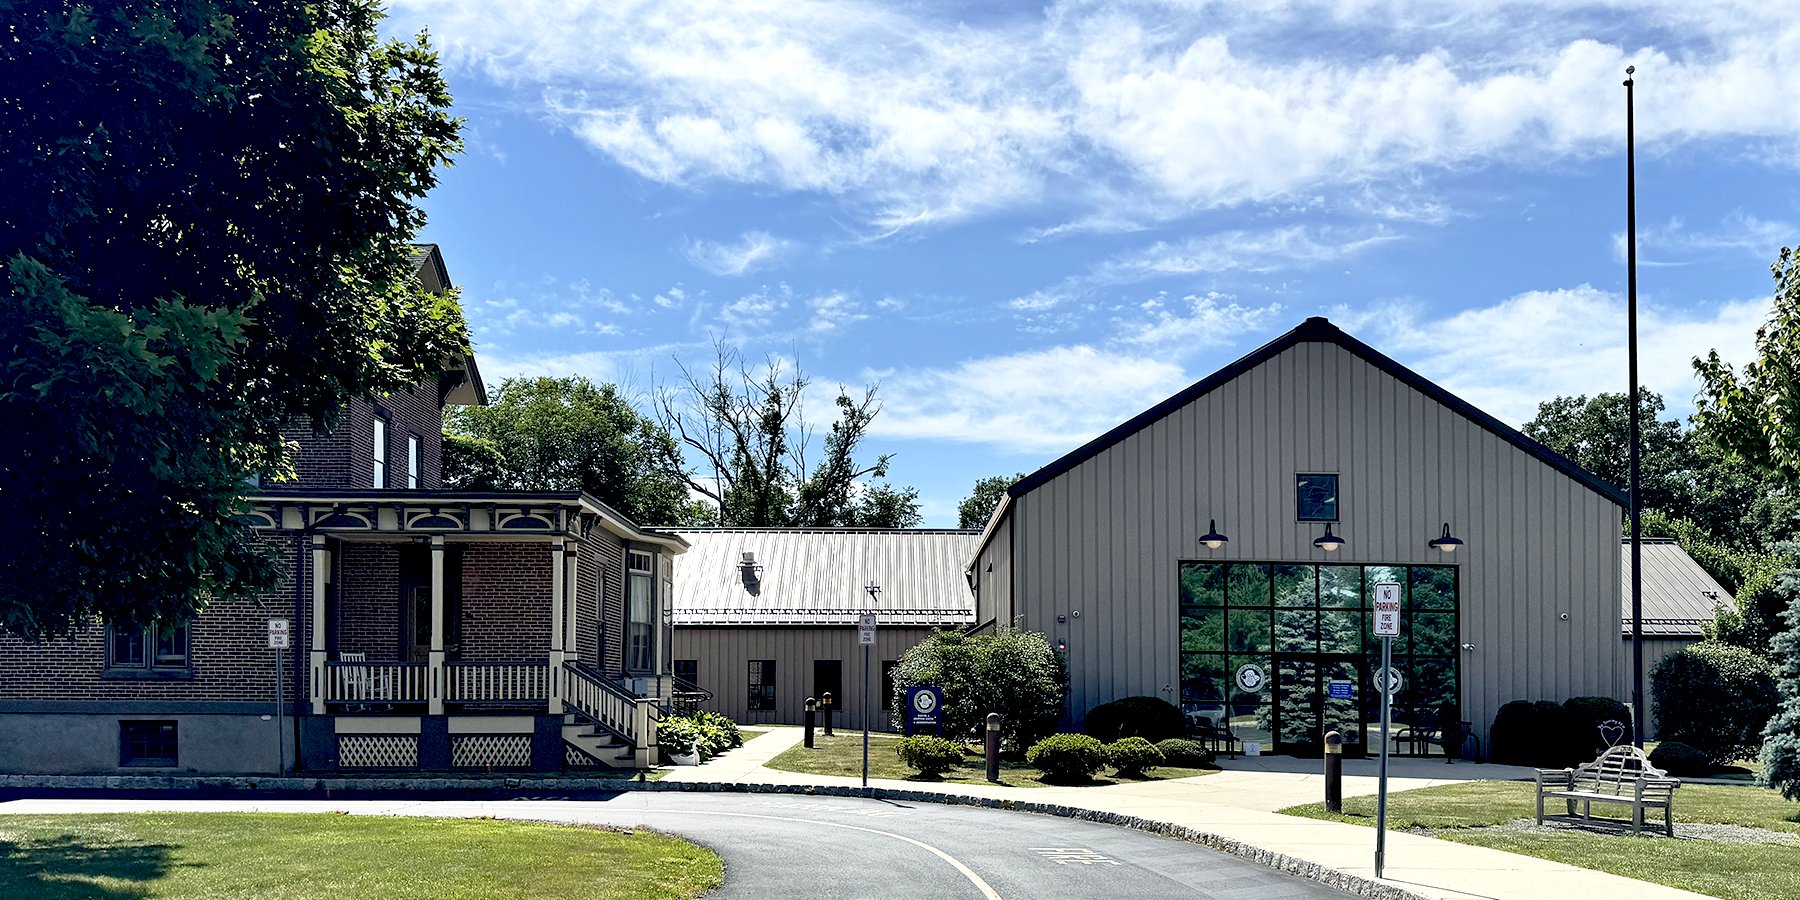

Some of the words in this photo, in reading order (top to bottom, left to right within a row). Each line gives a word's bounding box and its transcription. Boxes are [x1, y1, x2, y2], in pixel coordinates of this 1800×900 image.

[1383, 590, 1392, 600] NO
[1376, 602, 1399, 612] PARKING
[1380, 622, 1392, 630] ZONE
[1027, 847, 1122, 866] FIRE
